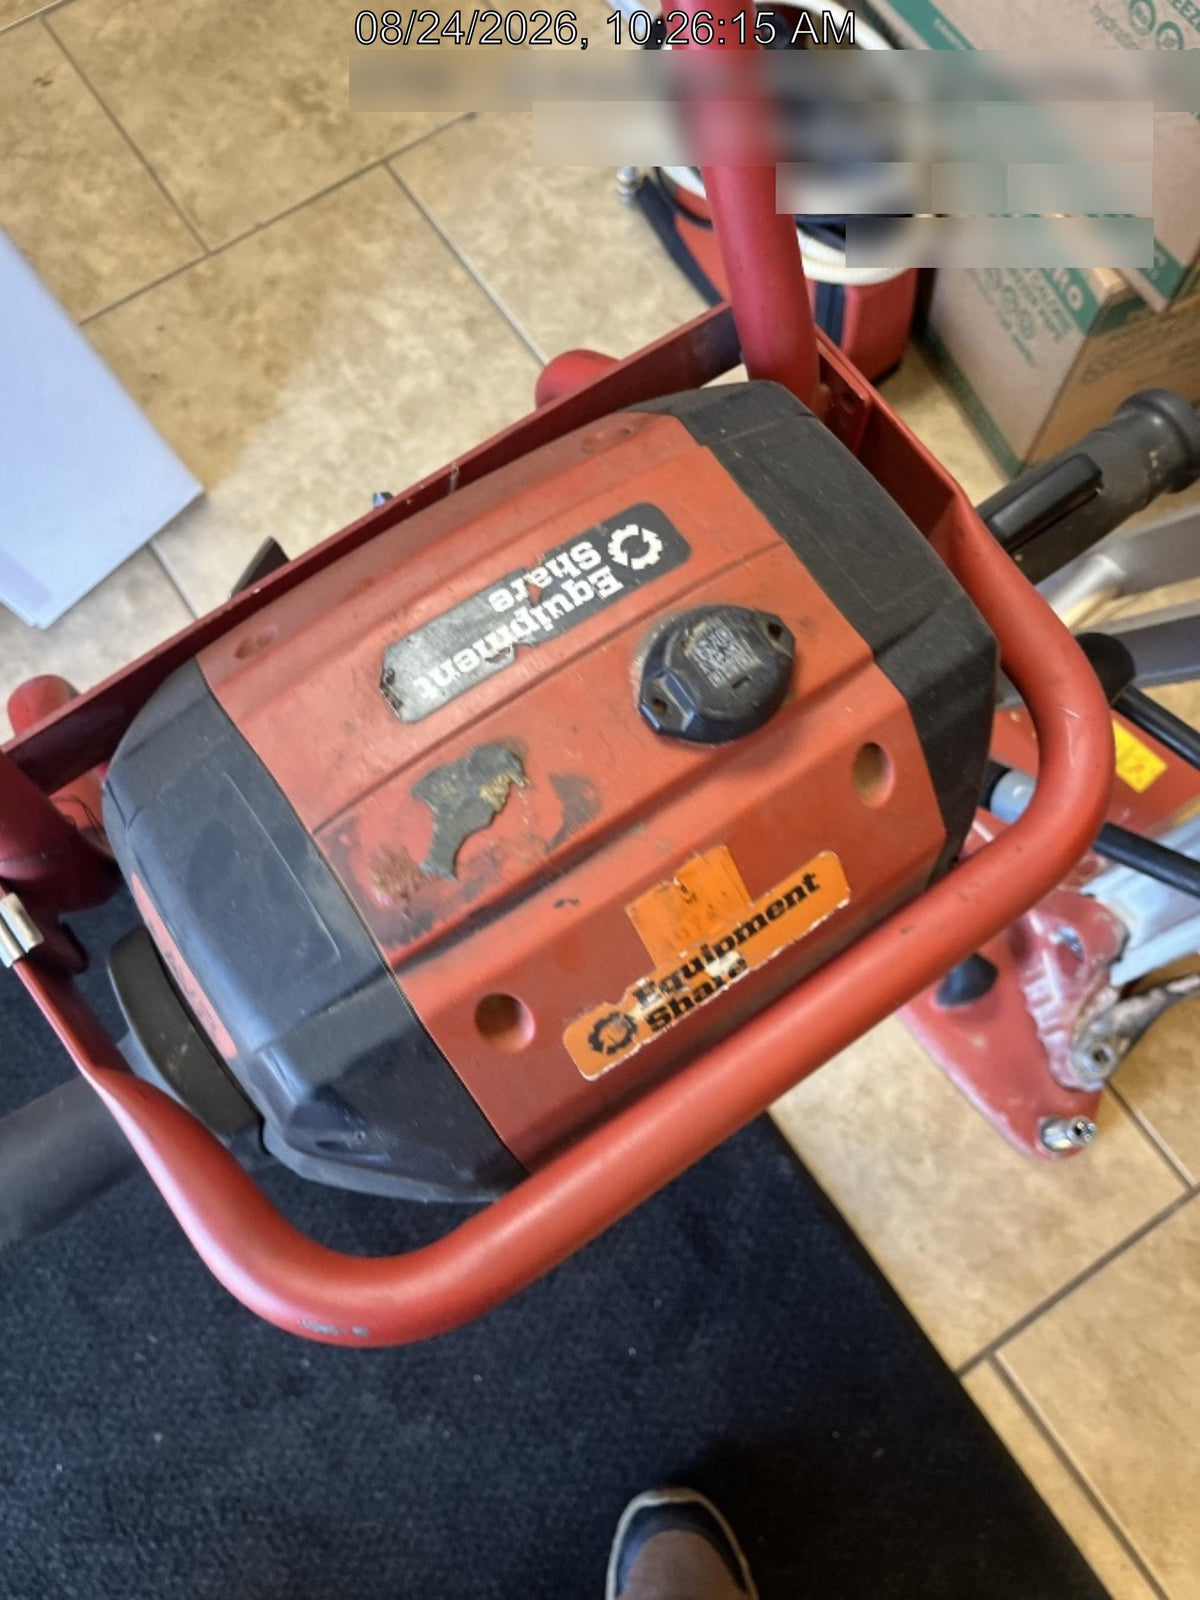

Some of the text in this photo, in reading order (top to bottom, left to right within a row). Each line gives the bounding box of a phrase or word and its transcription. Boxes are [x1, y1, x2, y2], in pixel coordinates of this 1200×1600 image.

[488, 541, 602, 612] Share
[412, 565, 624, 699] Equipment
[632, 872, 820, 1009] Equipment
[646, 956, 749, 1032] Share
